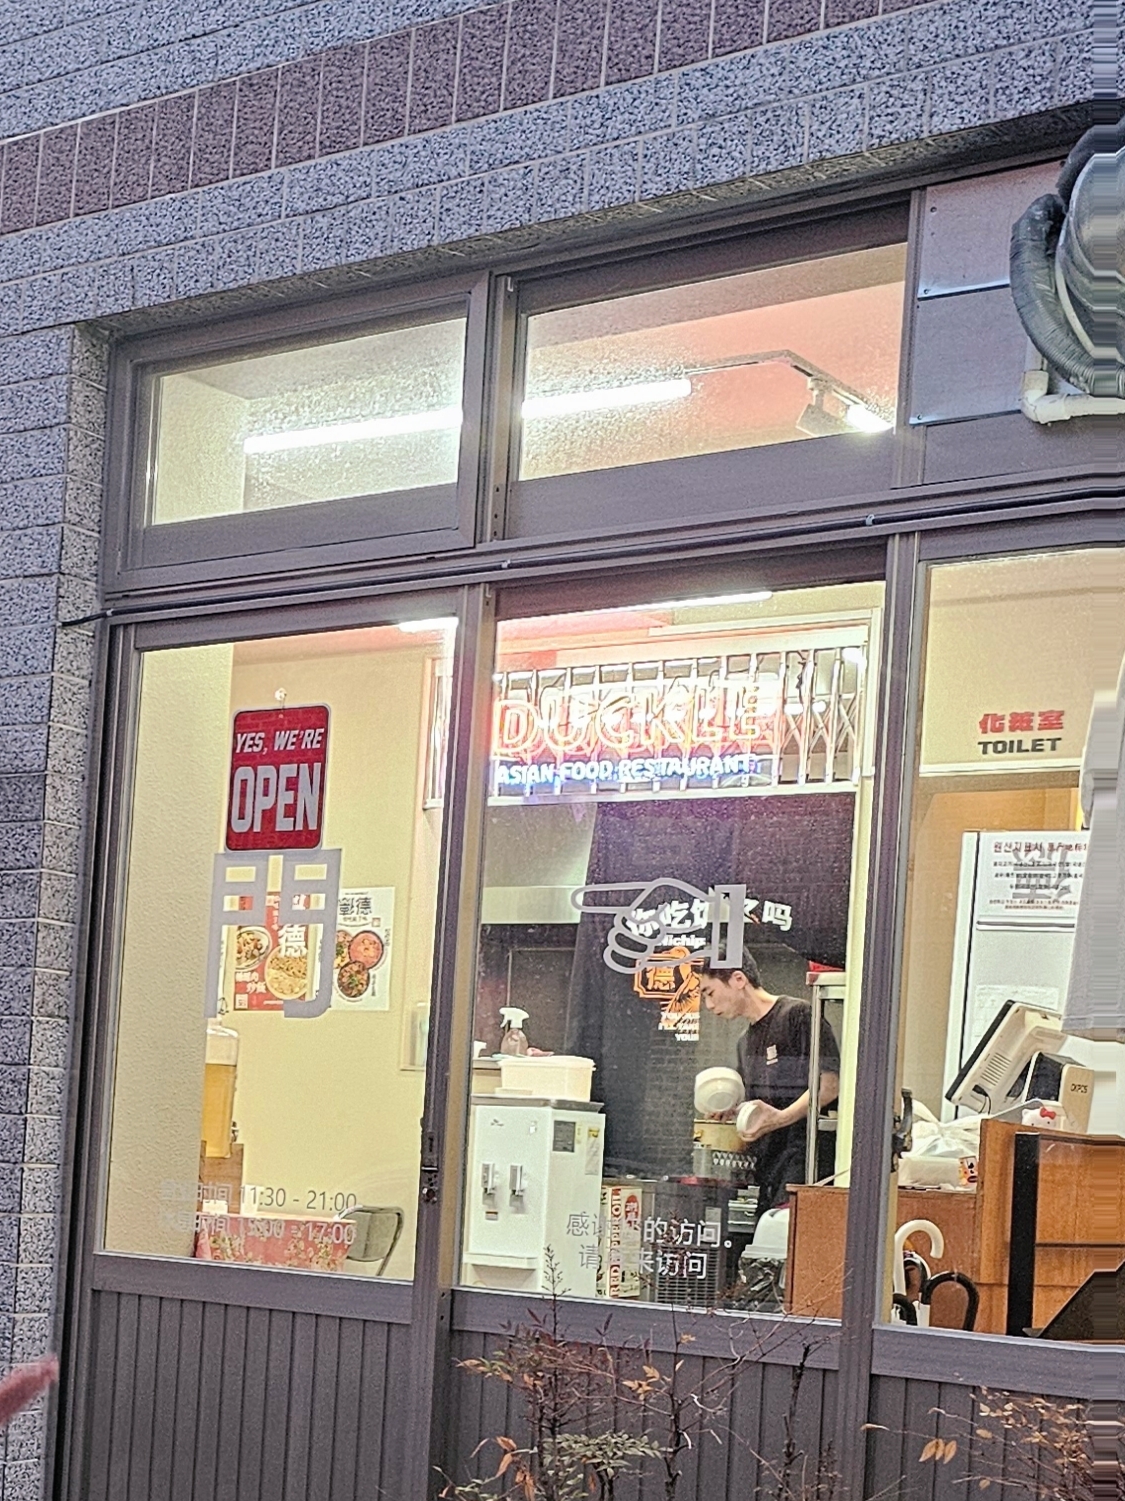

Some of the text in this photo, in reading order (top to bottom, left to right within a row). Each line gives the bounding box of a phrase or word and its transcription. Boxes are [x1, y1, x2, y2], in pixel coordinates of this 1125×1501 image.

[234, 727, 325, 756] YES, WE'RE
[977, 737, 1062, 755] TOILET
[497, 754, 756, 785] ASIAN FOOD RESTAURANT
[230, 762, 322, 834] OPEN
[240, 1185, 286, 1208] 11:30
[306, 1189, 357, 1212] 21:00
[304, 1221, 357, 1245] 17:00
[579, 1243, 708, 1280] 请来访问
